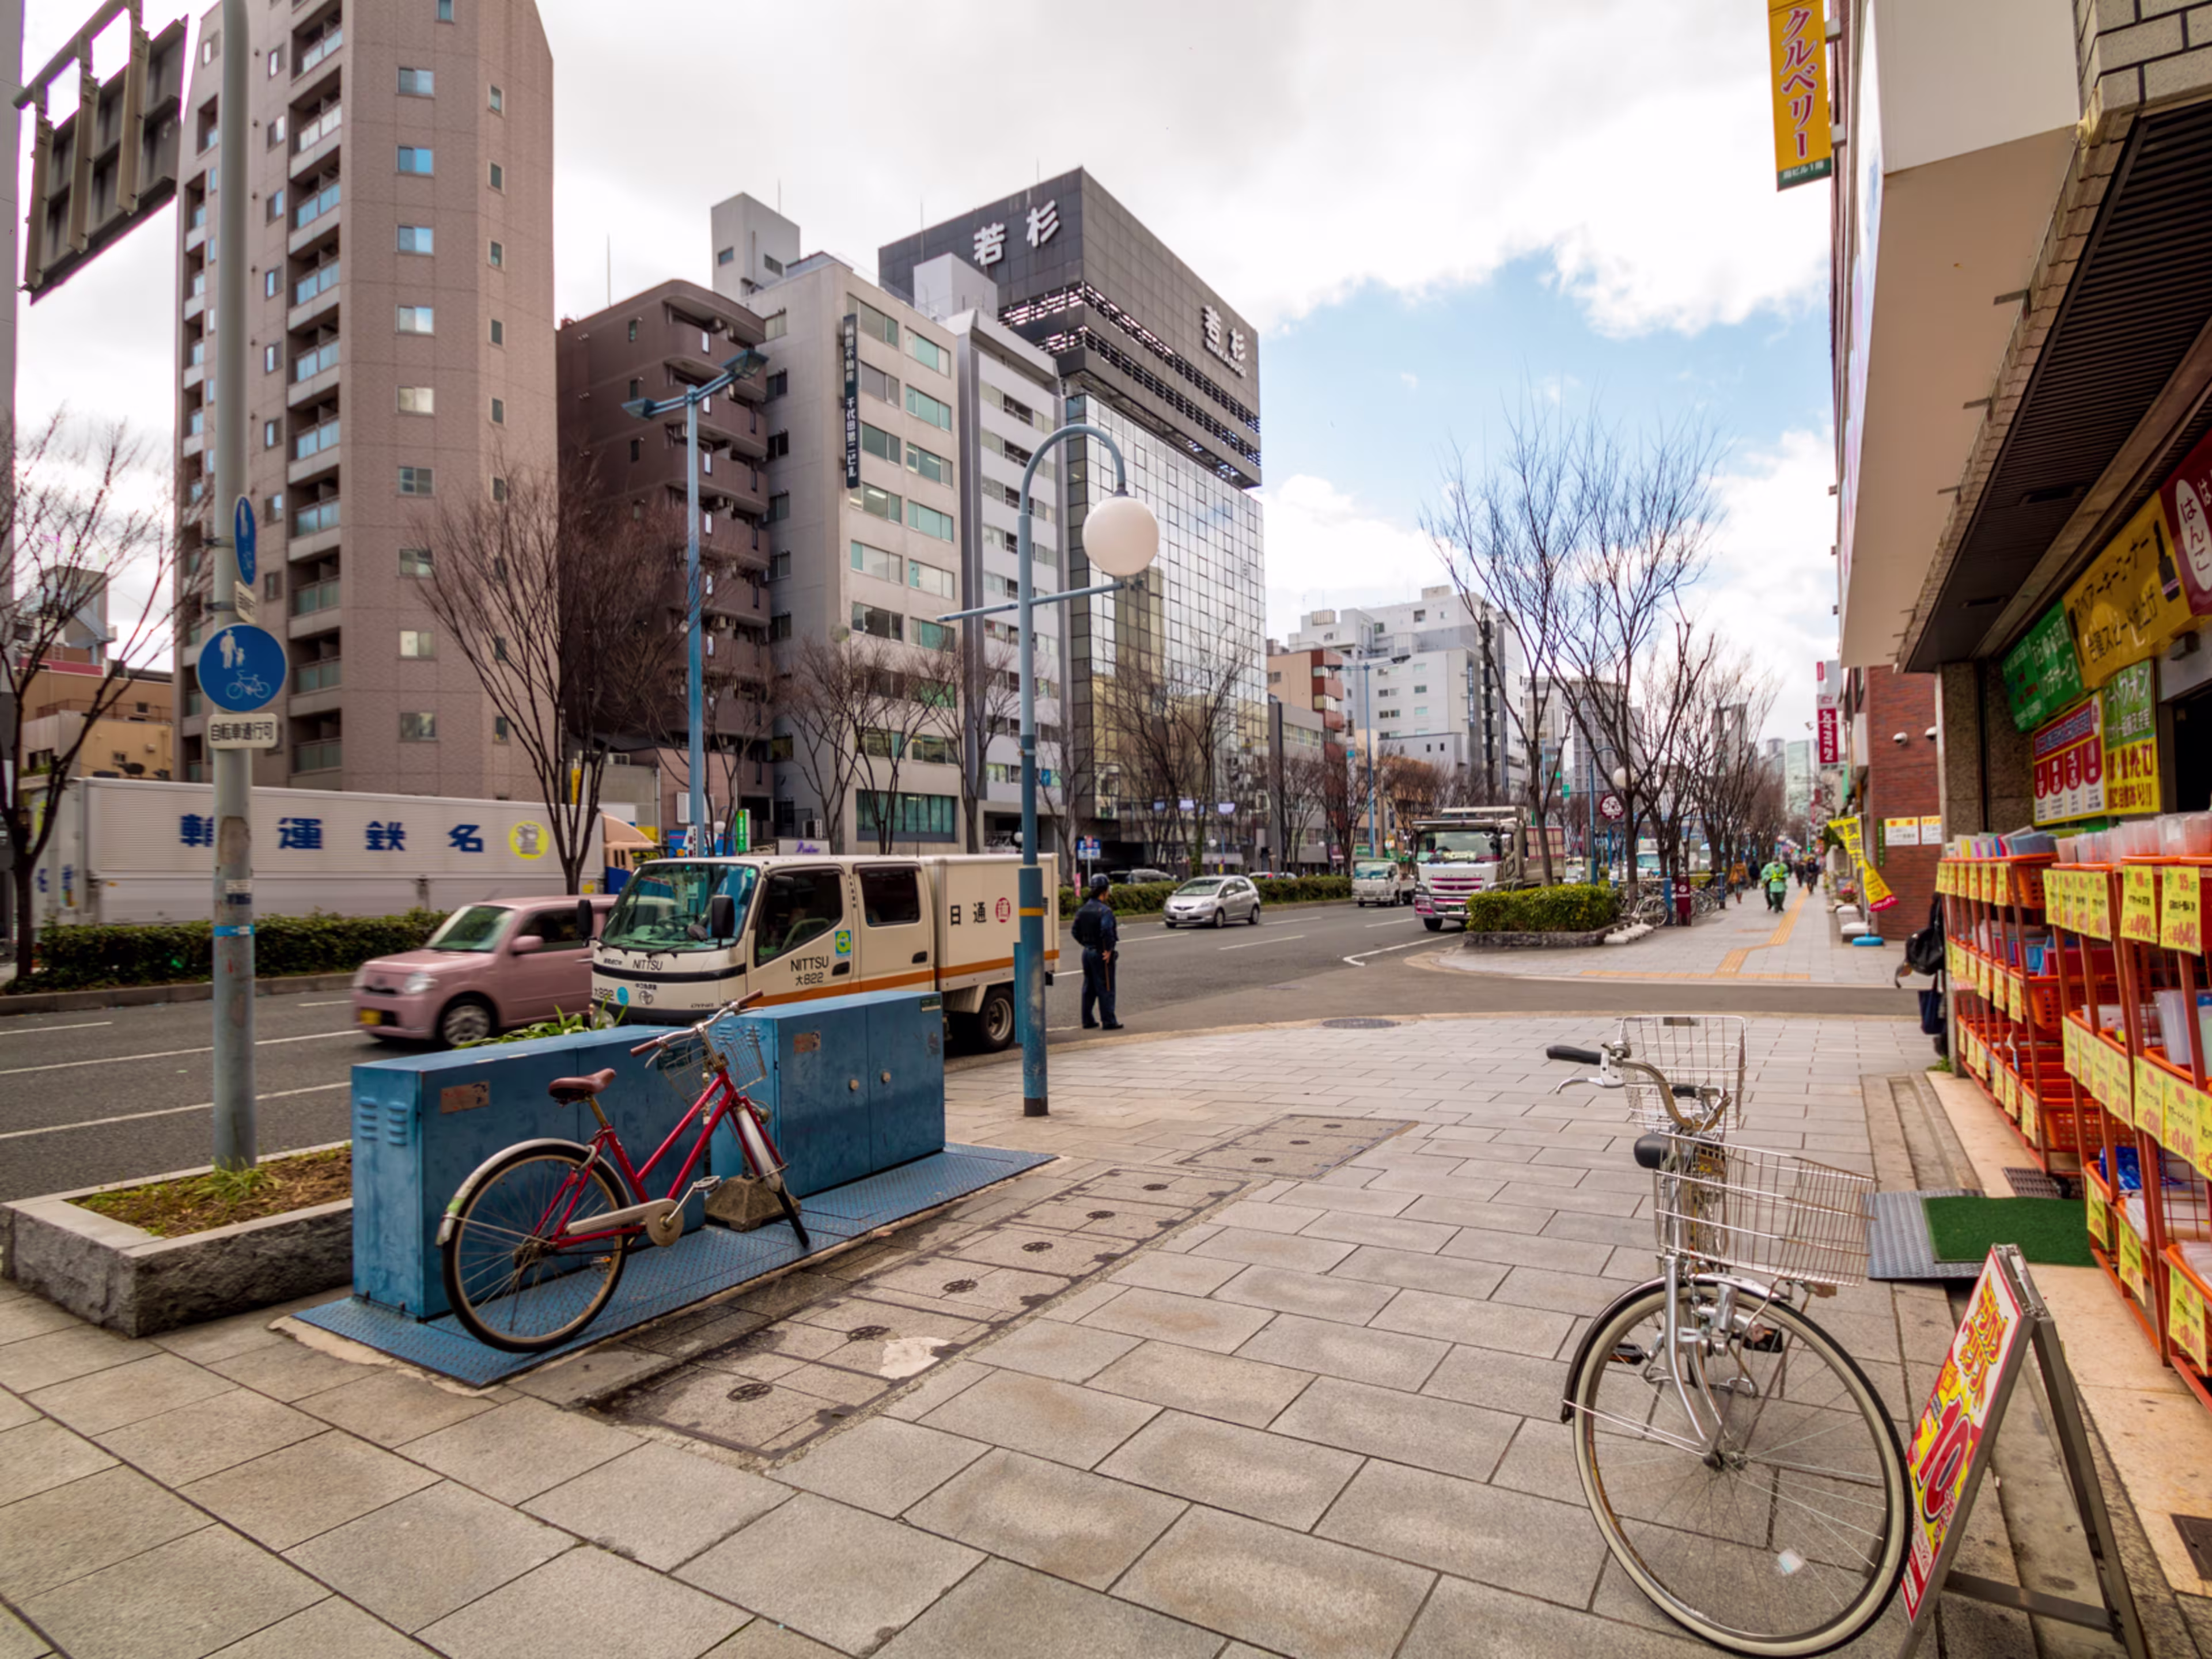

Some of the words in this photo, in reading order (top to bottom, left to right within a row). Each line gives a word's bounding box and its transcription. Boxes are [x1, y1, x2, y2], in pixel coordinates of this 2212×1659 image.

[1779, 7, 1817, 160] クルベリー
[974, 198, 1060, 266] 若杉
[1204, 305, 1247, 361] 若杉
[2180, 497, 2211, 573] はんこ
[210, 722, 274, 741] 自転車通行可
[633, 959, 664, 971] NITTSU
[790, 955, 829, 972] NITTSU
[796, 972, 824, 987] 大822
